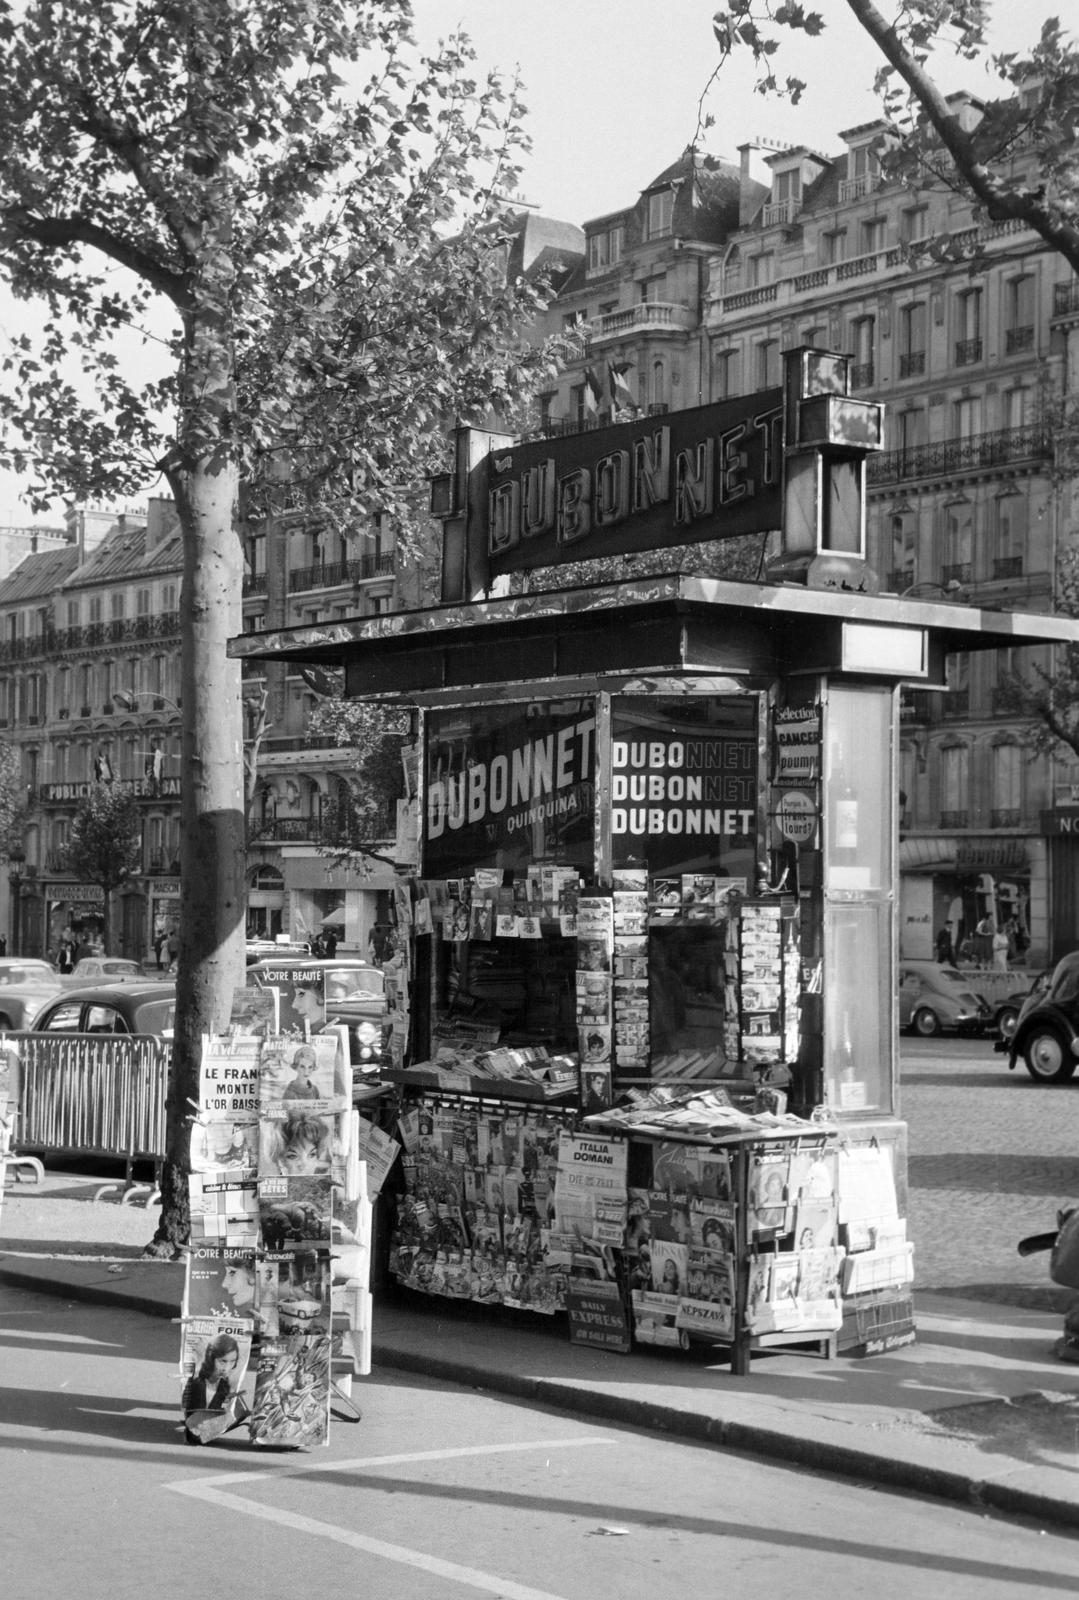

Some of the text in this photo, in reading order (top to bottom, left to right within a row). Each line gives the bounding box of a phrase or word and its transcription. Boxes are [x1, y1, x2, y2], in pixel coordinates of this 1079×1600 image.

[488, 406, 782, 557] DUBONNET
[428, 717, 595, 840] DUBONNET
[507, 794, 577, 834] QUINQUINA
[611, 808, 754, 835] DUBONNET
[784, 821, 812, 835] lourd?
[263, 970, 289, 981] VOTRE
[205, 1068, 261, 1079] LE FRAN
[216, 1083, 255, 1094] MONTE
[205, 1098, 227, 1110] L'OR
[580, 1142, 609, 1154] ITALIA
[573, 1152, 614, 1165] DOMANI
[570, 1310, 624, 1328] EXPRESS
[217, 1326, 244, 1336] FOIE
